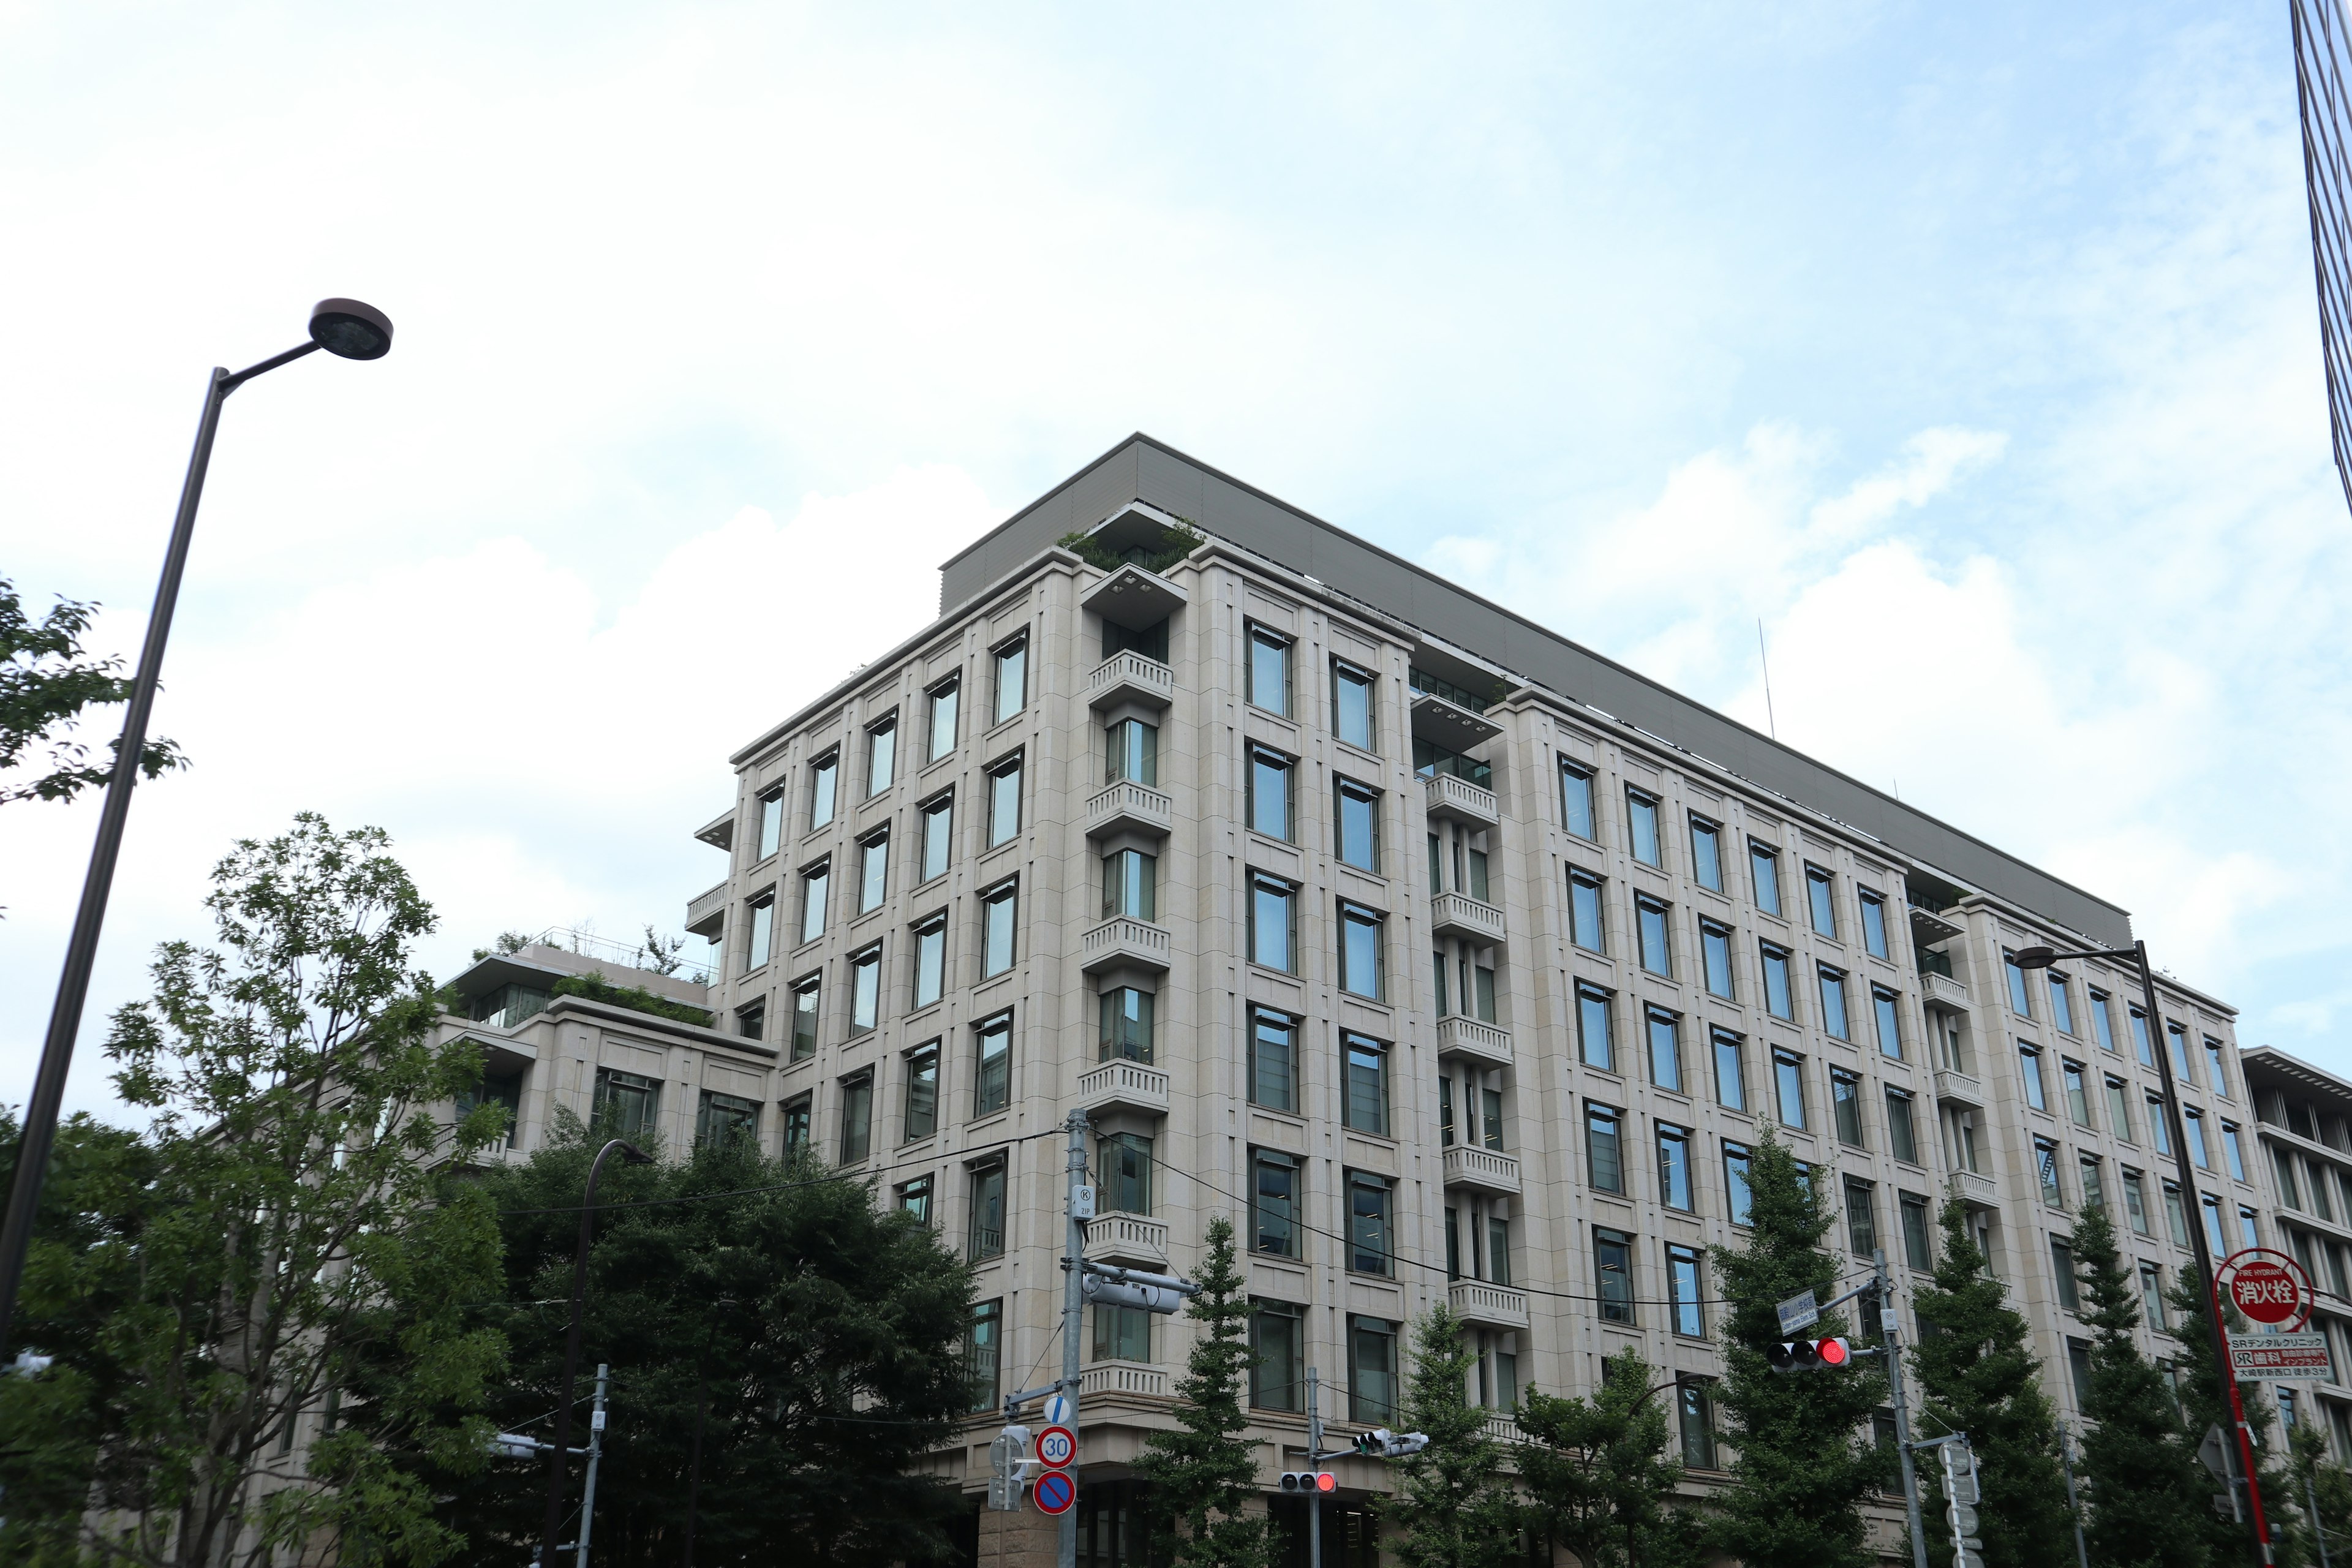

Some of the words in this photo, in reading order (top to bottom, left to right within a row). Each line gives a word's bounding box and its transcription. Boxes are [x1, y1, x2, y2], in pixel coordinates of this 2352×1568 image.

[2236, 1280, 2296, 1305] 消火栓
[2232, 1338, 2323, 1348] SRデンタルクリニック
[2253, 1351, 2282, 1365] 歯科
[2284, 1357, 2328, 1366] インプラント
[2240, 1368, 2292, 1377] 大崎駅新西口
[2293, 1367, 2328, 1376] 徒歩3分
[1046, 1438, 1068, 1457] 30
